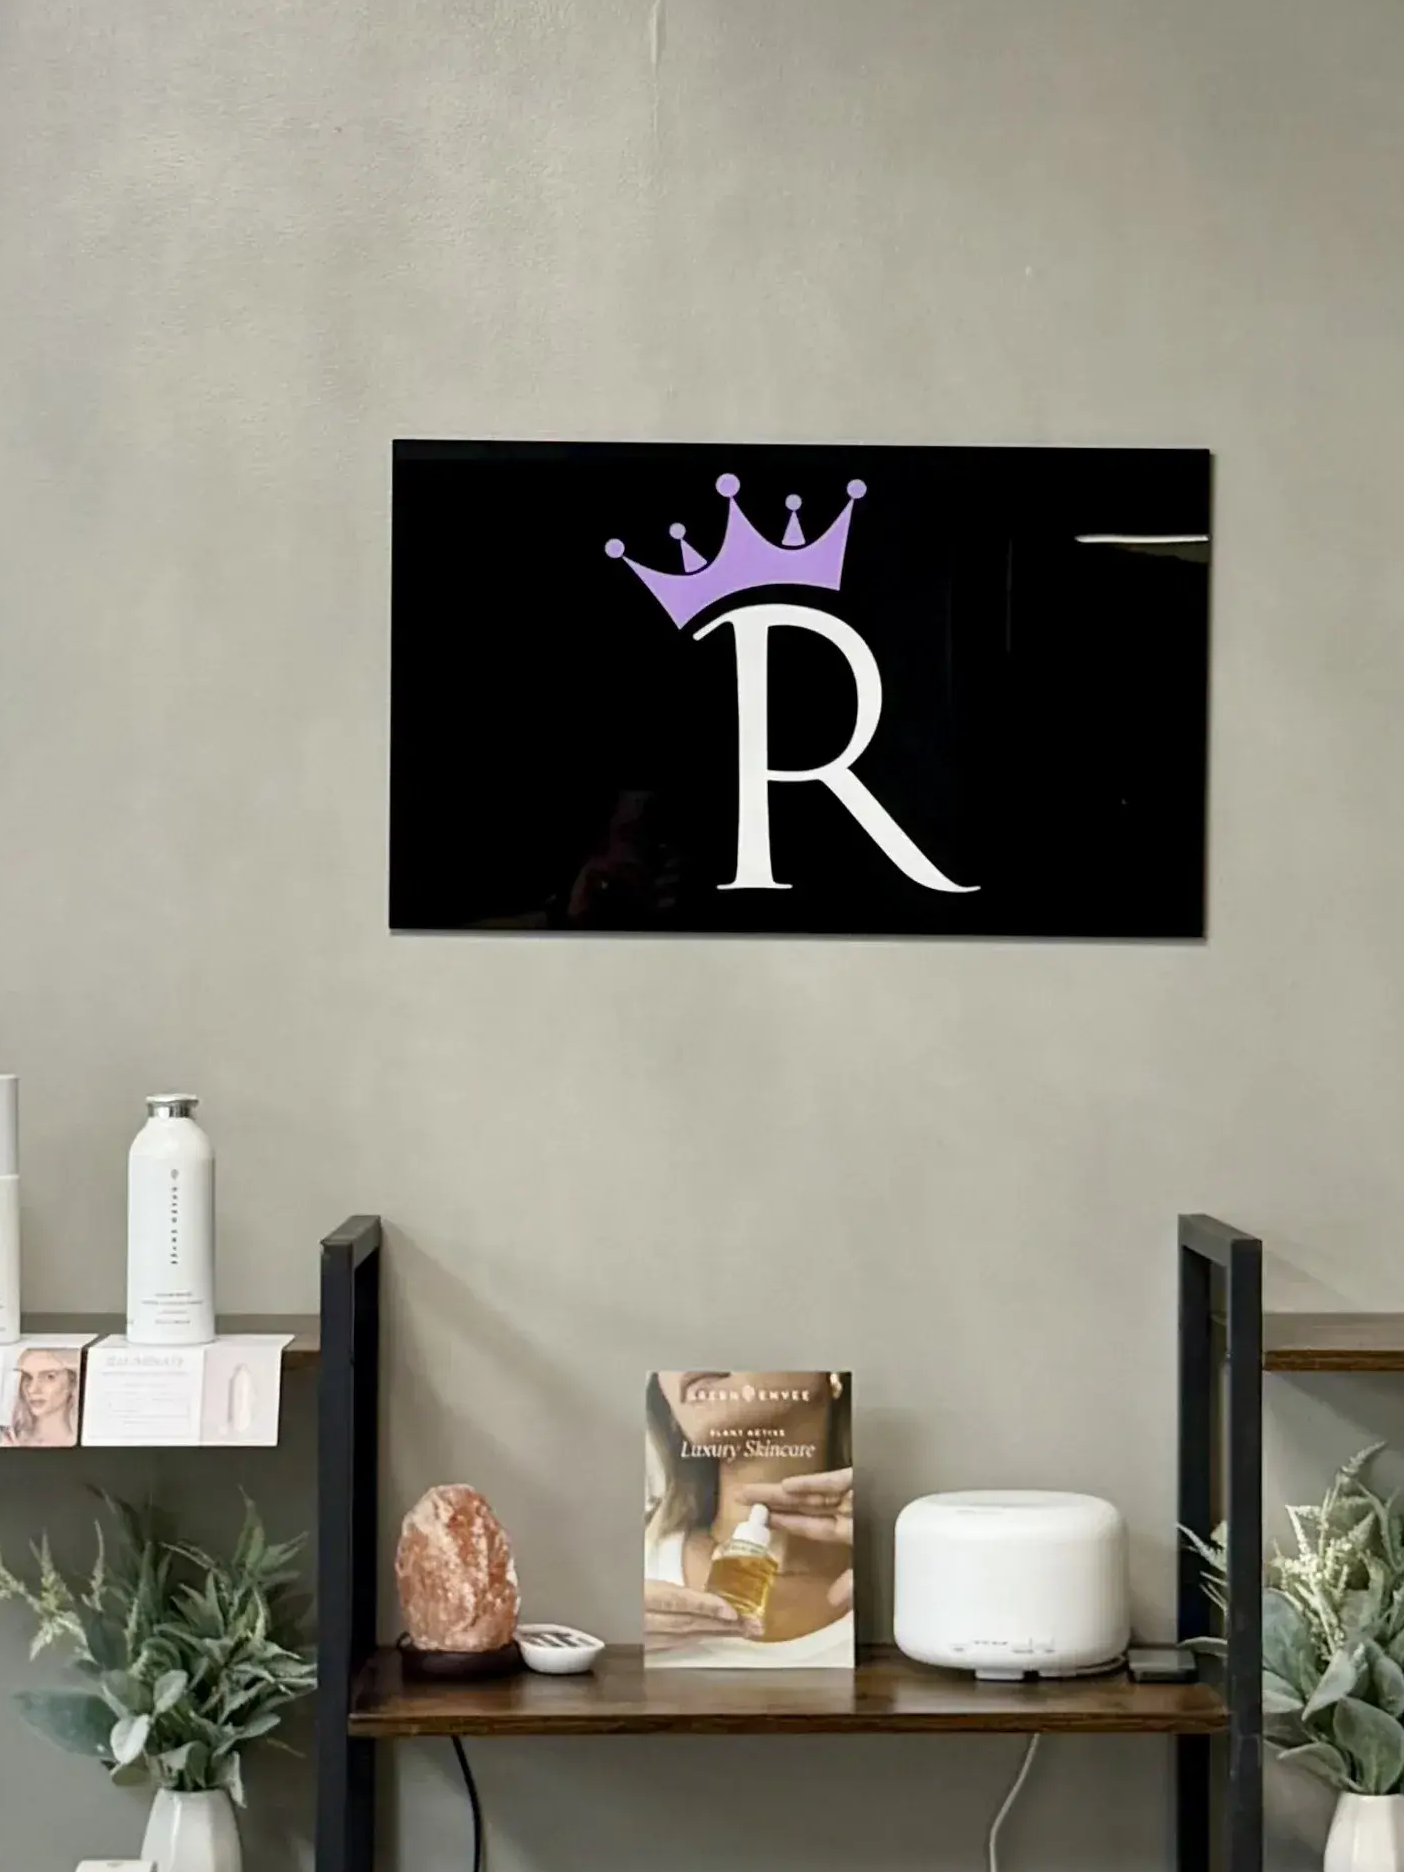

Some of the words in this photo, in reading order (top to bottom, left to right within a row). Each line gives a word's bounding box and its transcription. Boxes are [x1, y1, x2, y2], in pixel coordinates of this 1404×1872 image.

[692, 602, 982, 894] R
[681, 1440, 738, 1462] Luxury
[743, 1438, 816, 1458] Skincare
